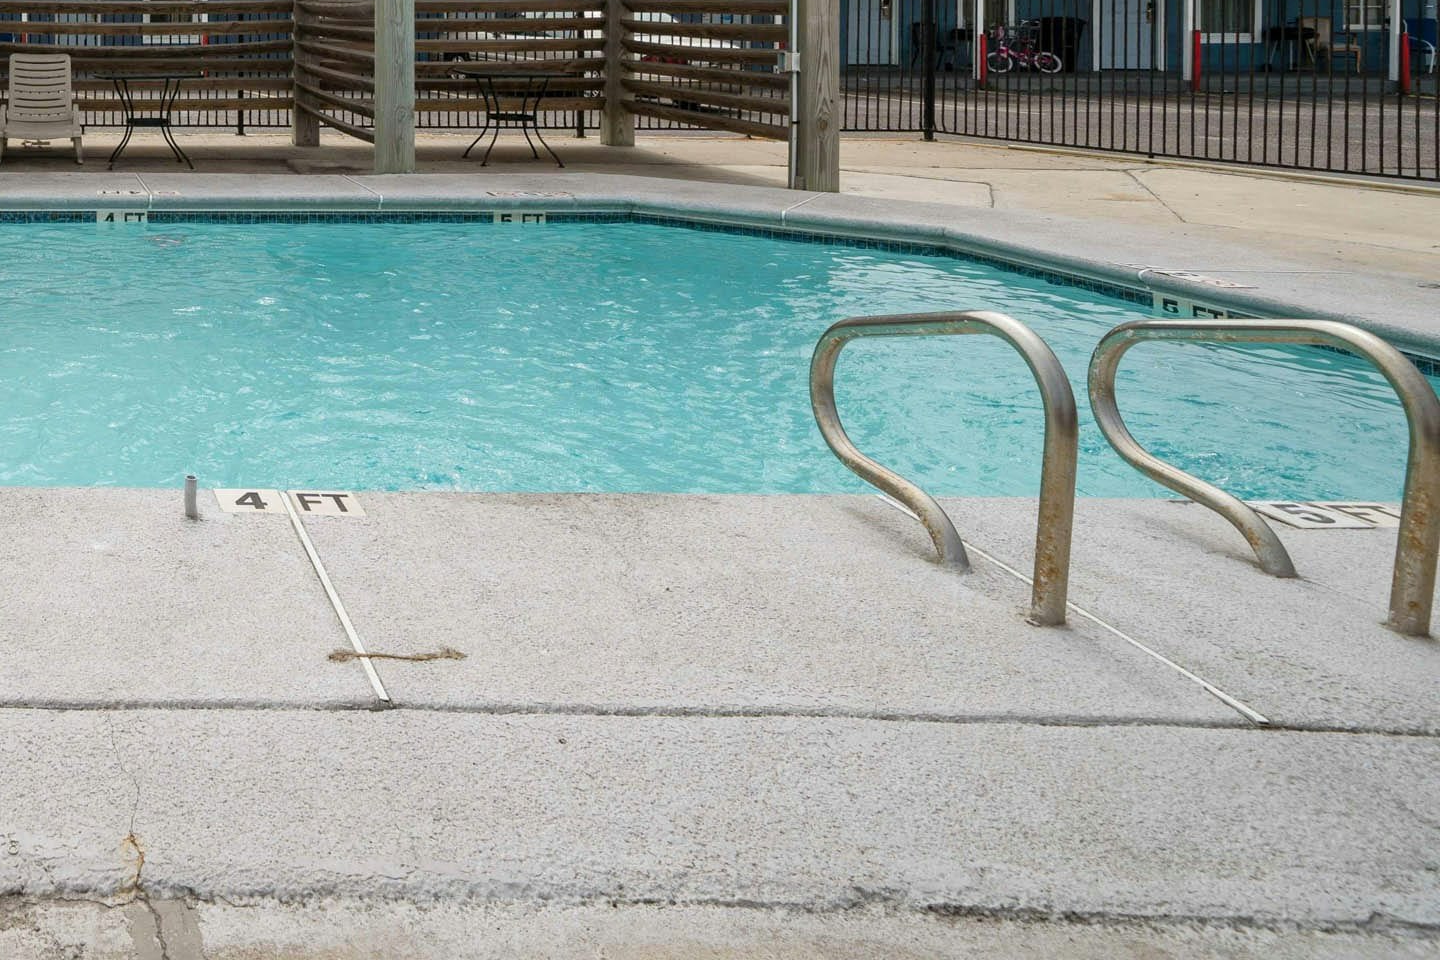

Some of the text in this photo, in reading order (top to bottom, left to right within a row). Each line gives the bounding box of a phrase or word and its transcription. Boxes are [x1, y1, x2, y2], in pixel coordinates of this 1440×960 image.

[235, 491, 349, 513] 4 FT
[1268, 503, 1337, 524] 5
